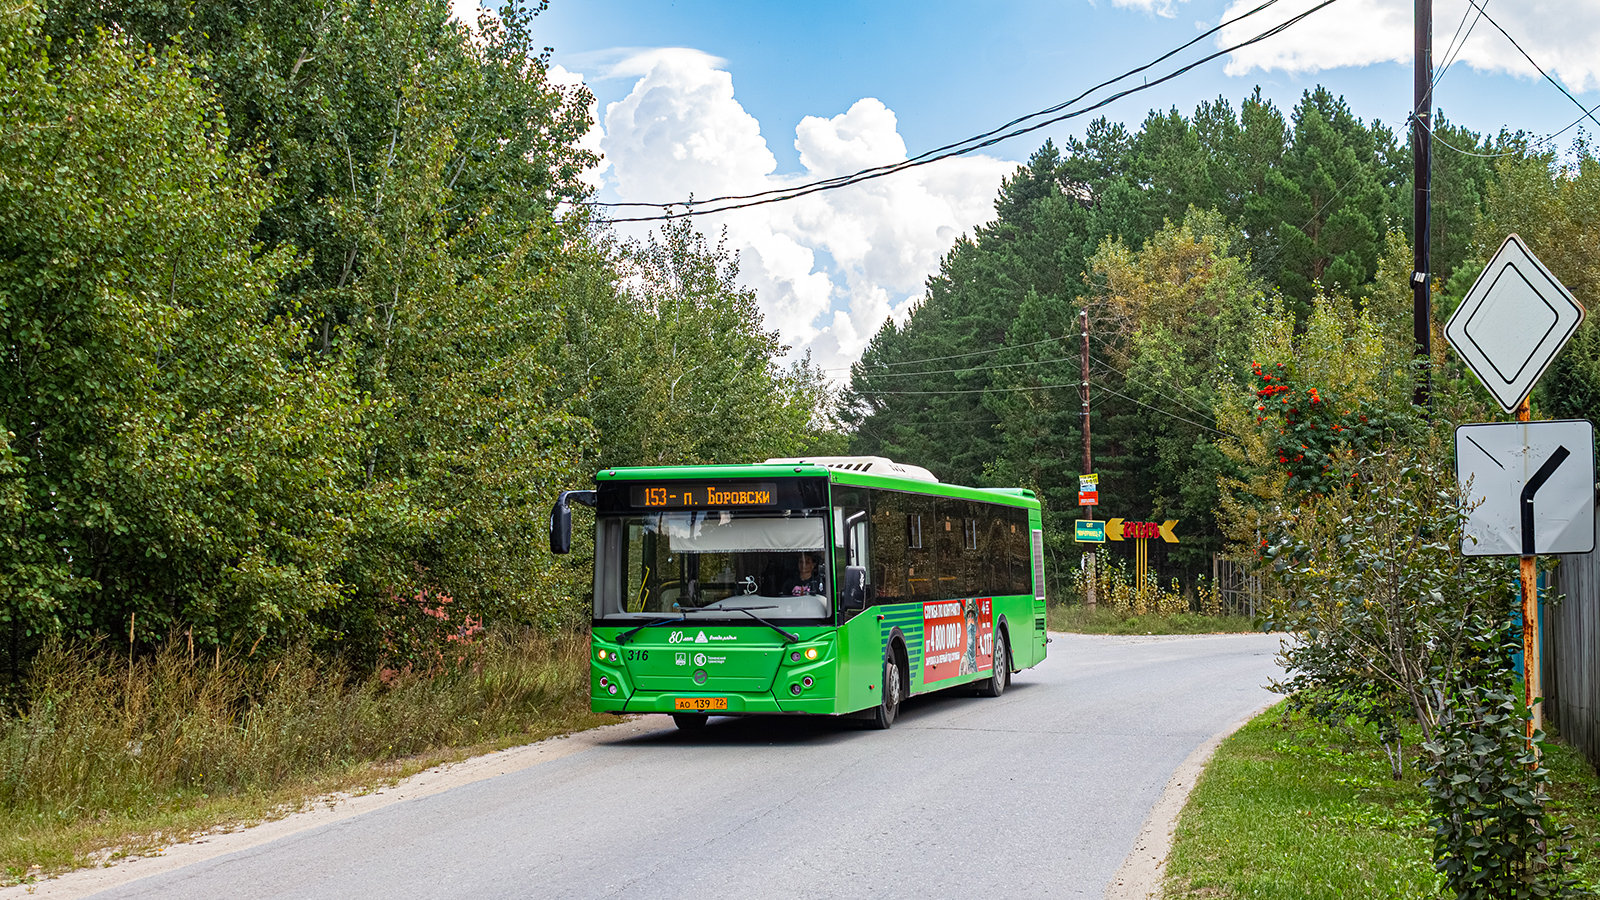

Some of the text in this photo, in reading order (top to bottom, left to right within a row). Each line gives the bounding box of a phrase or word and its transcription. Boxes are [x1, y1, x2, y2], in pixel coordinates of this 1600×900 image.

[683, 491, 698, 505] п.
[707, 487, 770, 505] Боровски
[669, 631, 683, 644] 80
[931, 626, 935, 652] 4
[935, 624, 945, 651] 800
[946, 623, 956, 649] 000
[984, 633, 992, 655] 117
[628, 650, 648, 661] 316
[695, 699, 710, 708] 139
[715, 698, 724, 706] 72
